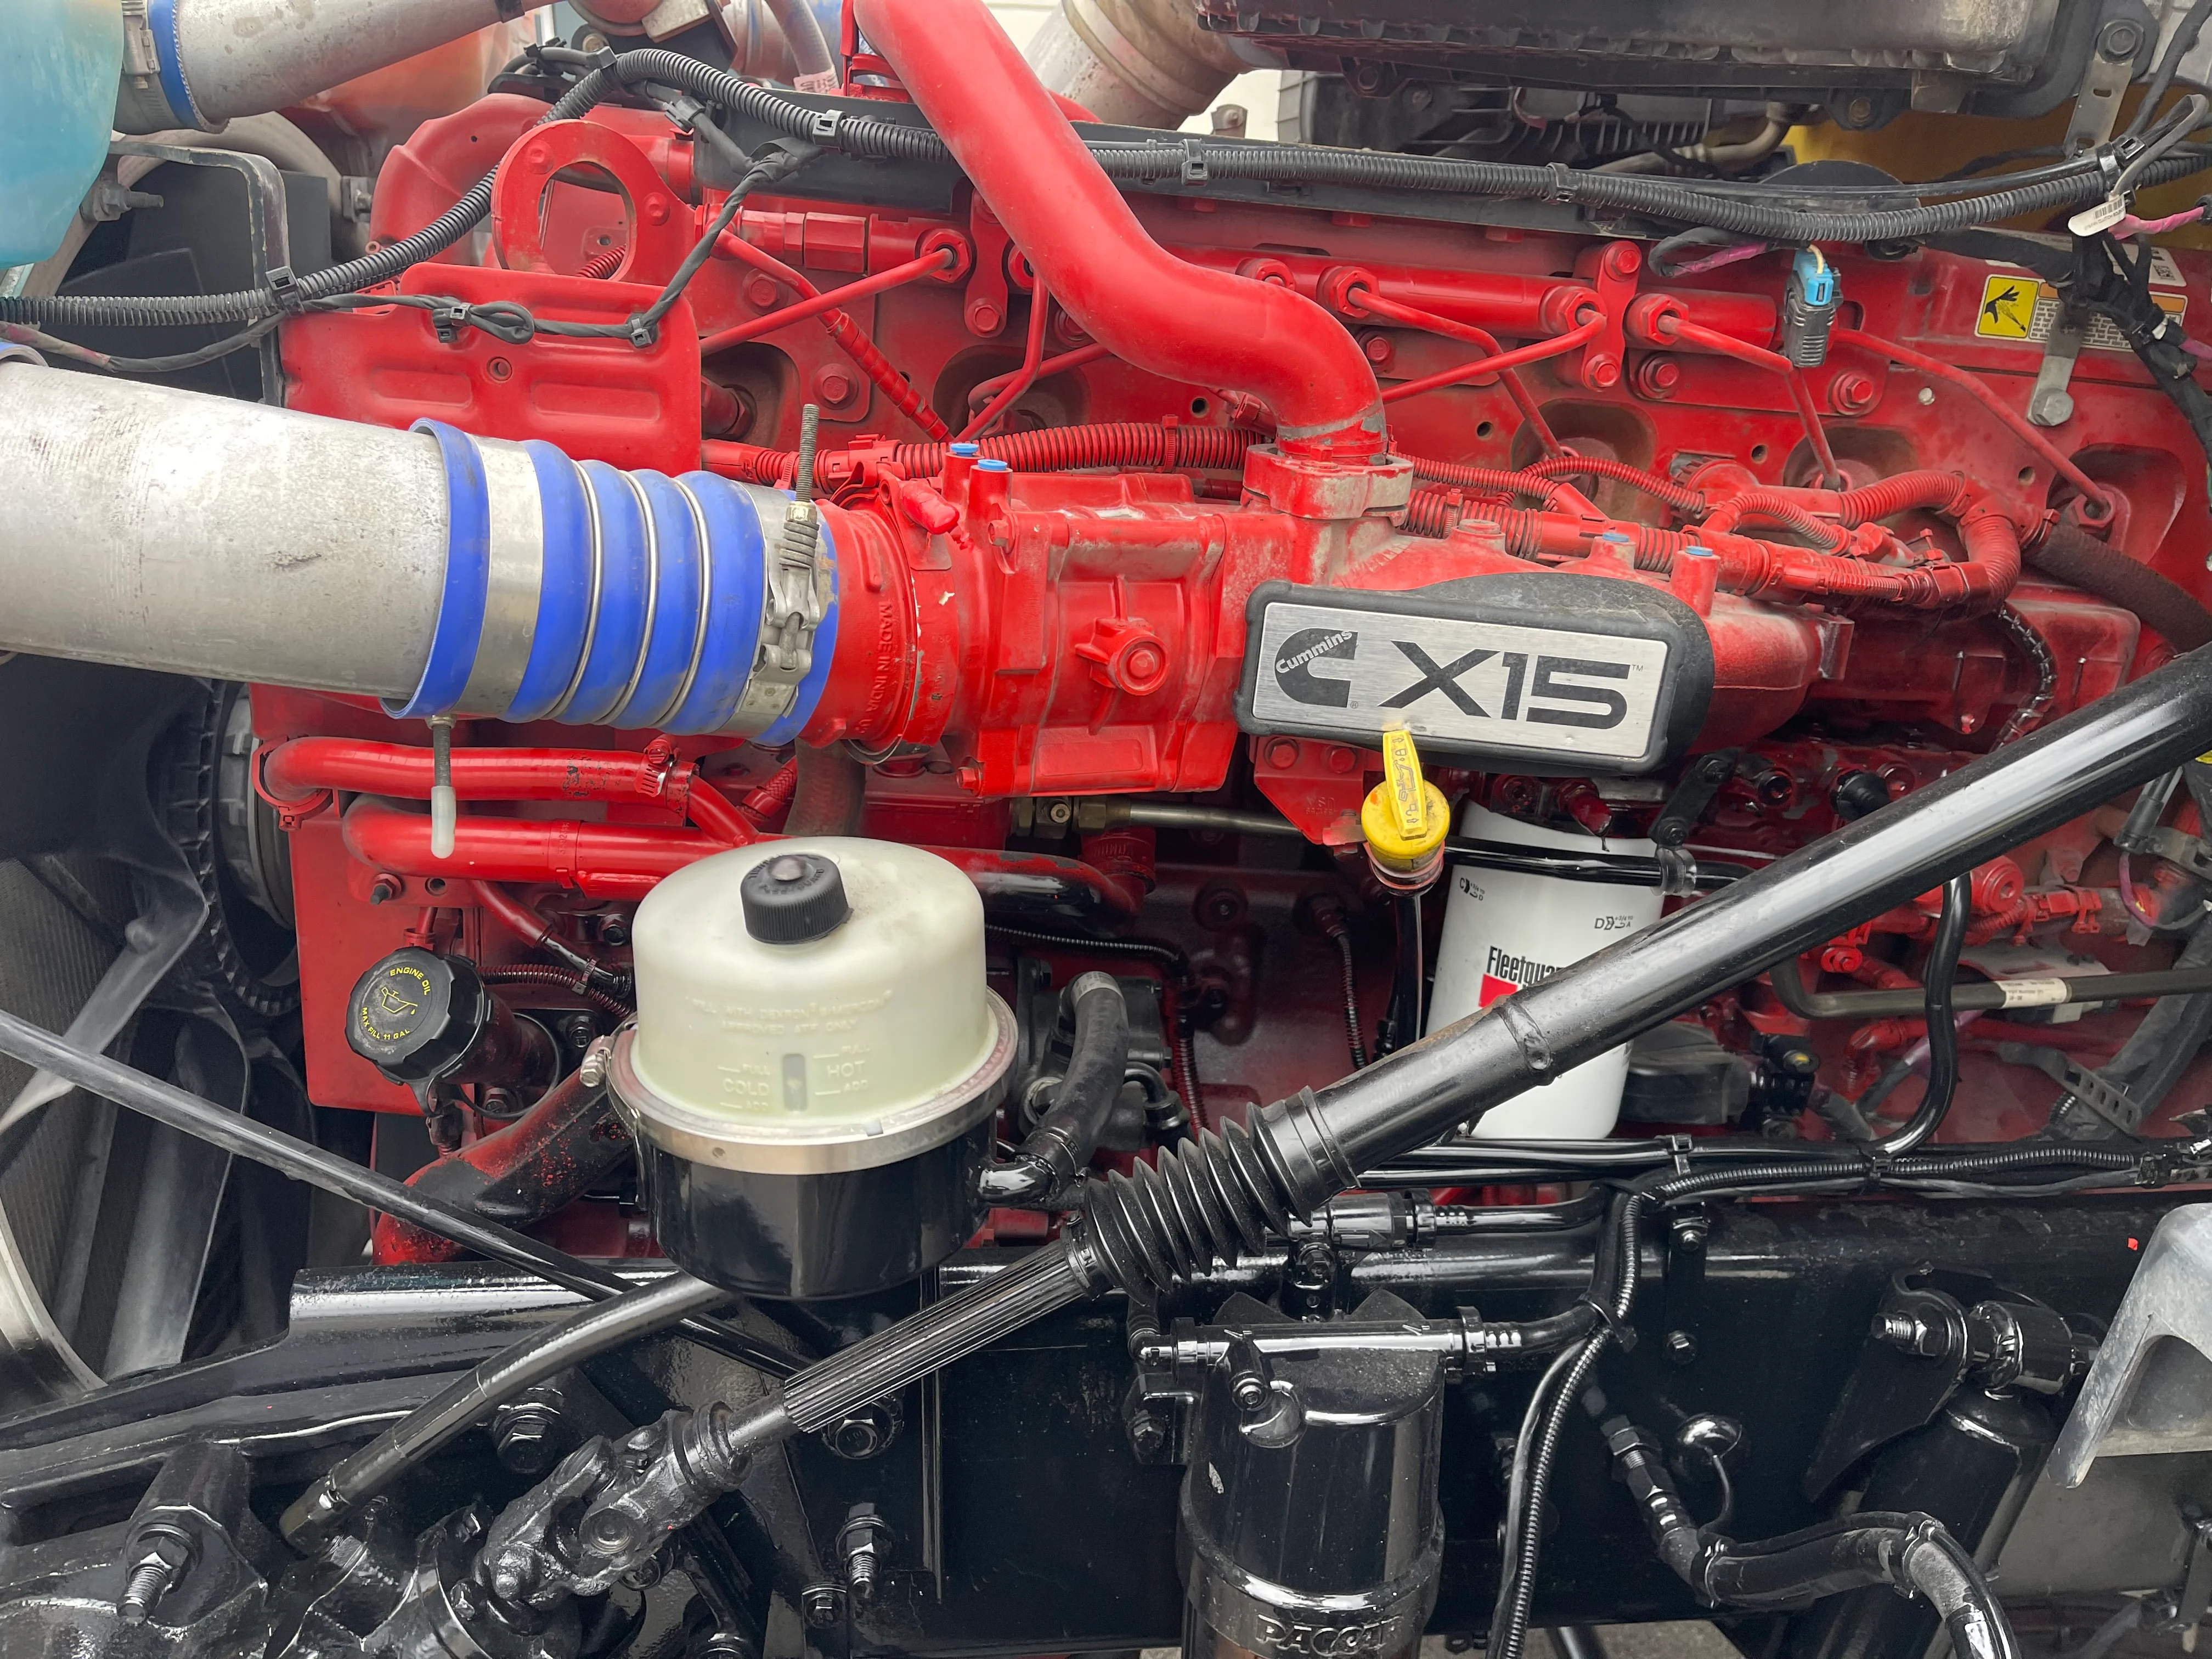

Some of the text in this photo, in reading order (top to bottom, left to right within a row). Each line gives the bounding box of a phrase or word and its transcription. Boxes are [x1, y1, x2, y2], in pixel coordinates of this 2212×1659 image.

[1276, 630, 1353, 673] Cummins
[1377, 639, 1631, 730] X15
[390, 967, 431, 996] ENGINE OIL
[362, 1007, 370, 1027] MAX
[368, 1026, 380, 1039] FILL
[393, 1029, 410, 1040] GAL
[827, 1060, 866, 1079] HOT
[723, 1077, 770, 1096] COLD
